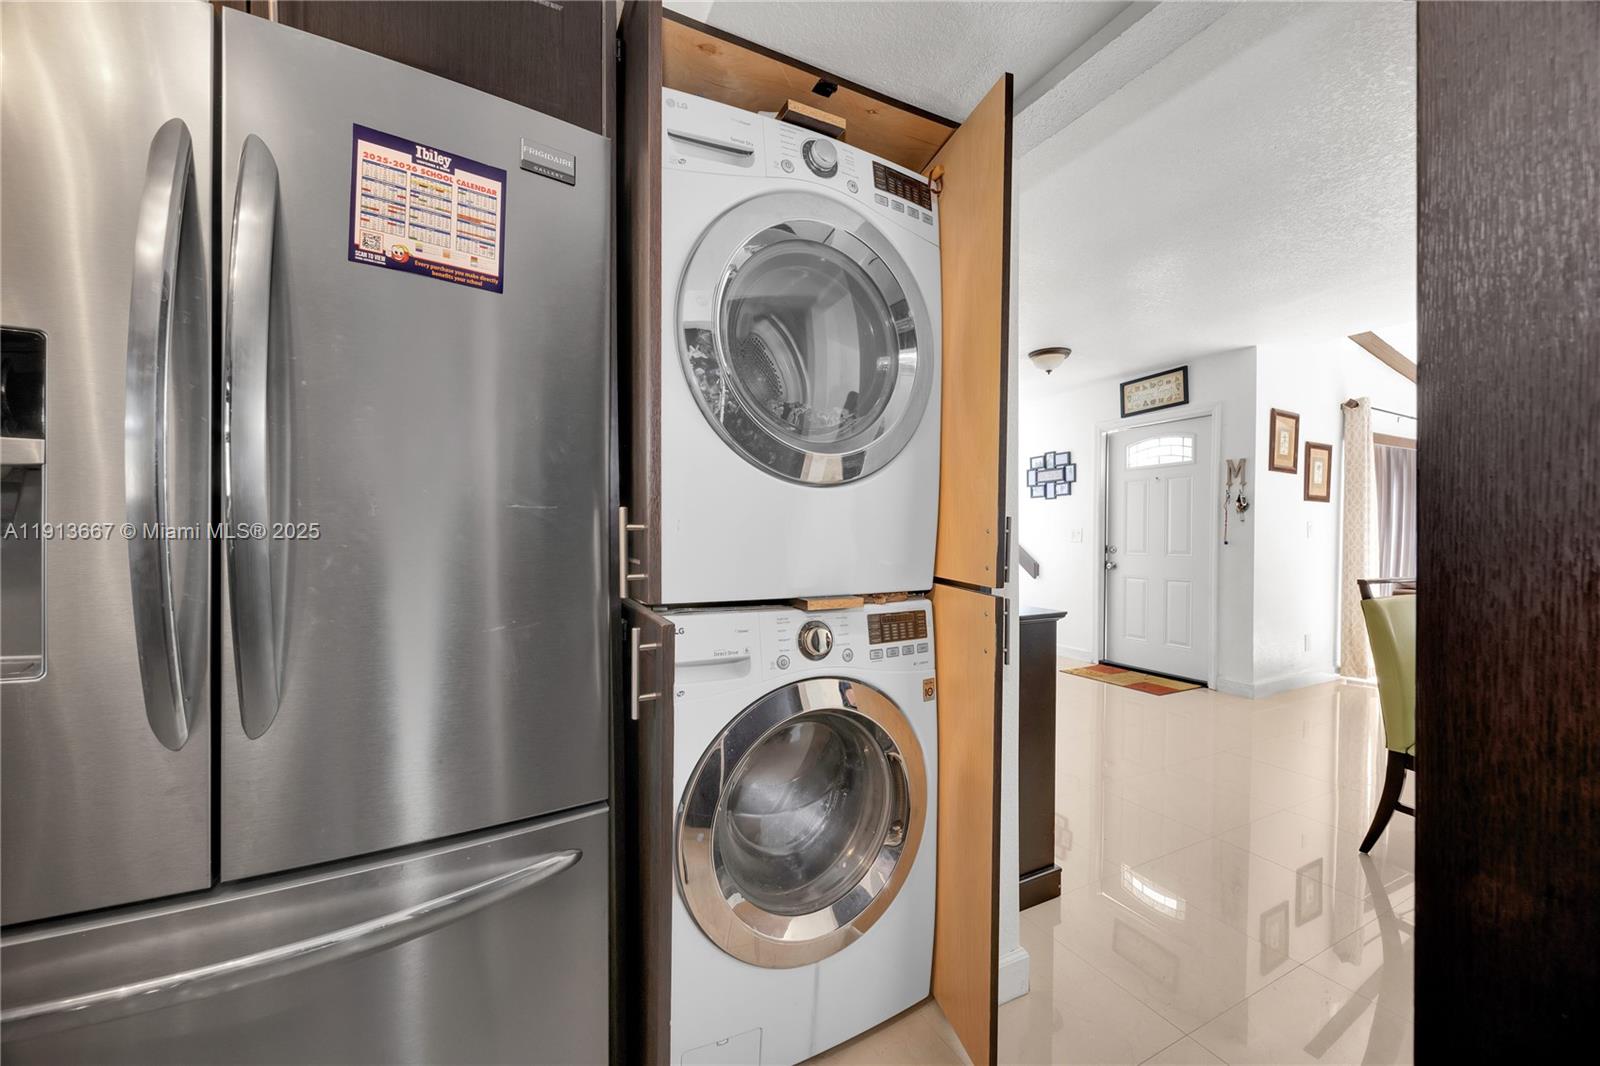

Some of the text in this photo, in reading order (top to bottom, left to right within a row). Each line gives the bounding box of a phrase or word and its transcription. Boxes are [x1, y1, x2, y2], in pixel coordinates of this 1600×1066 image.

[415, 145, 452, 168] Ibiley
[363, 151, 418, 172] 2025-2026
[420, 168, 454, 184] SCHOOL
[456, 178, 497, 196] CALENDAR
[355, 249, 368, 258] SCAN
[368, 252, 374, 260] TO
[374, 254, 386, 262] VIEW
[414, 259, 430, 269] Every
[430, 264, 454, 274] purchase
[465, 271, 479, 279] make
[479, 275, 499, 285] directly
[431, 270, 454, 279] benefits
[467, 279, 483, 287] school
[1225, 457, 1247, 487] M
